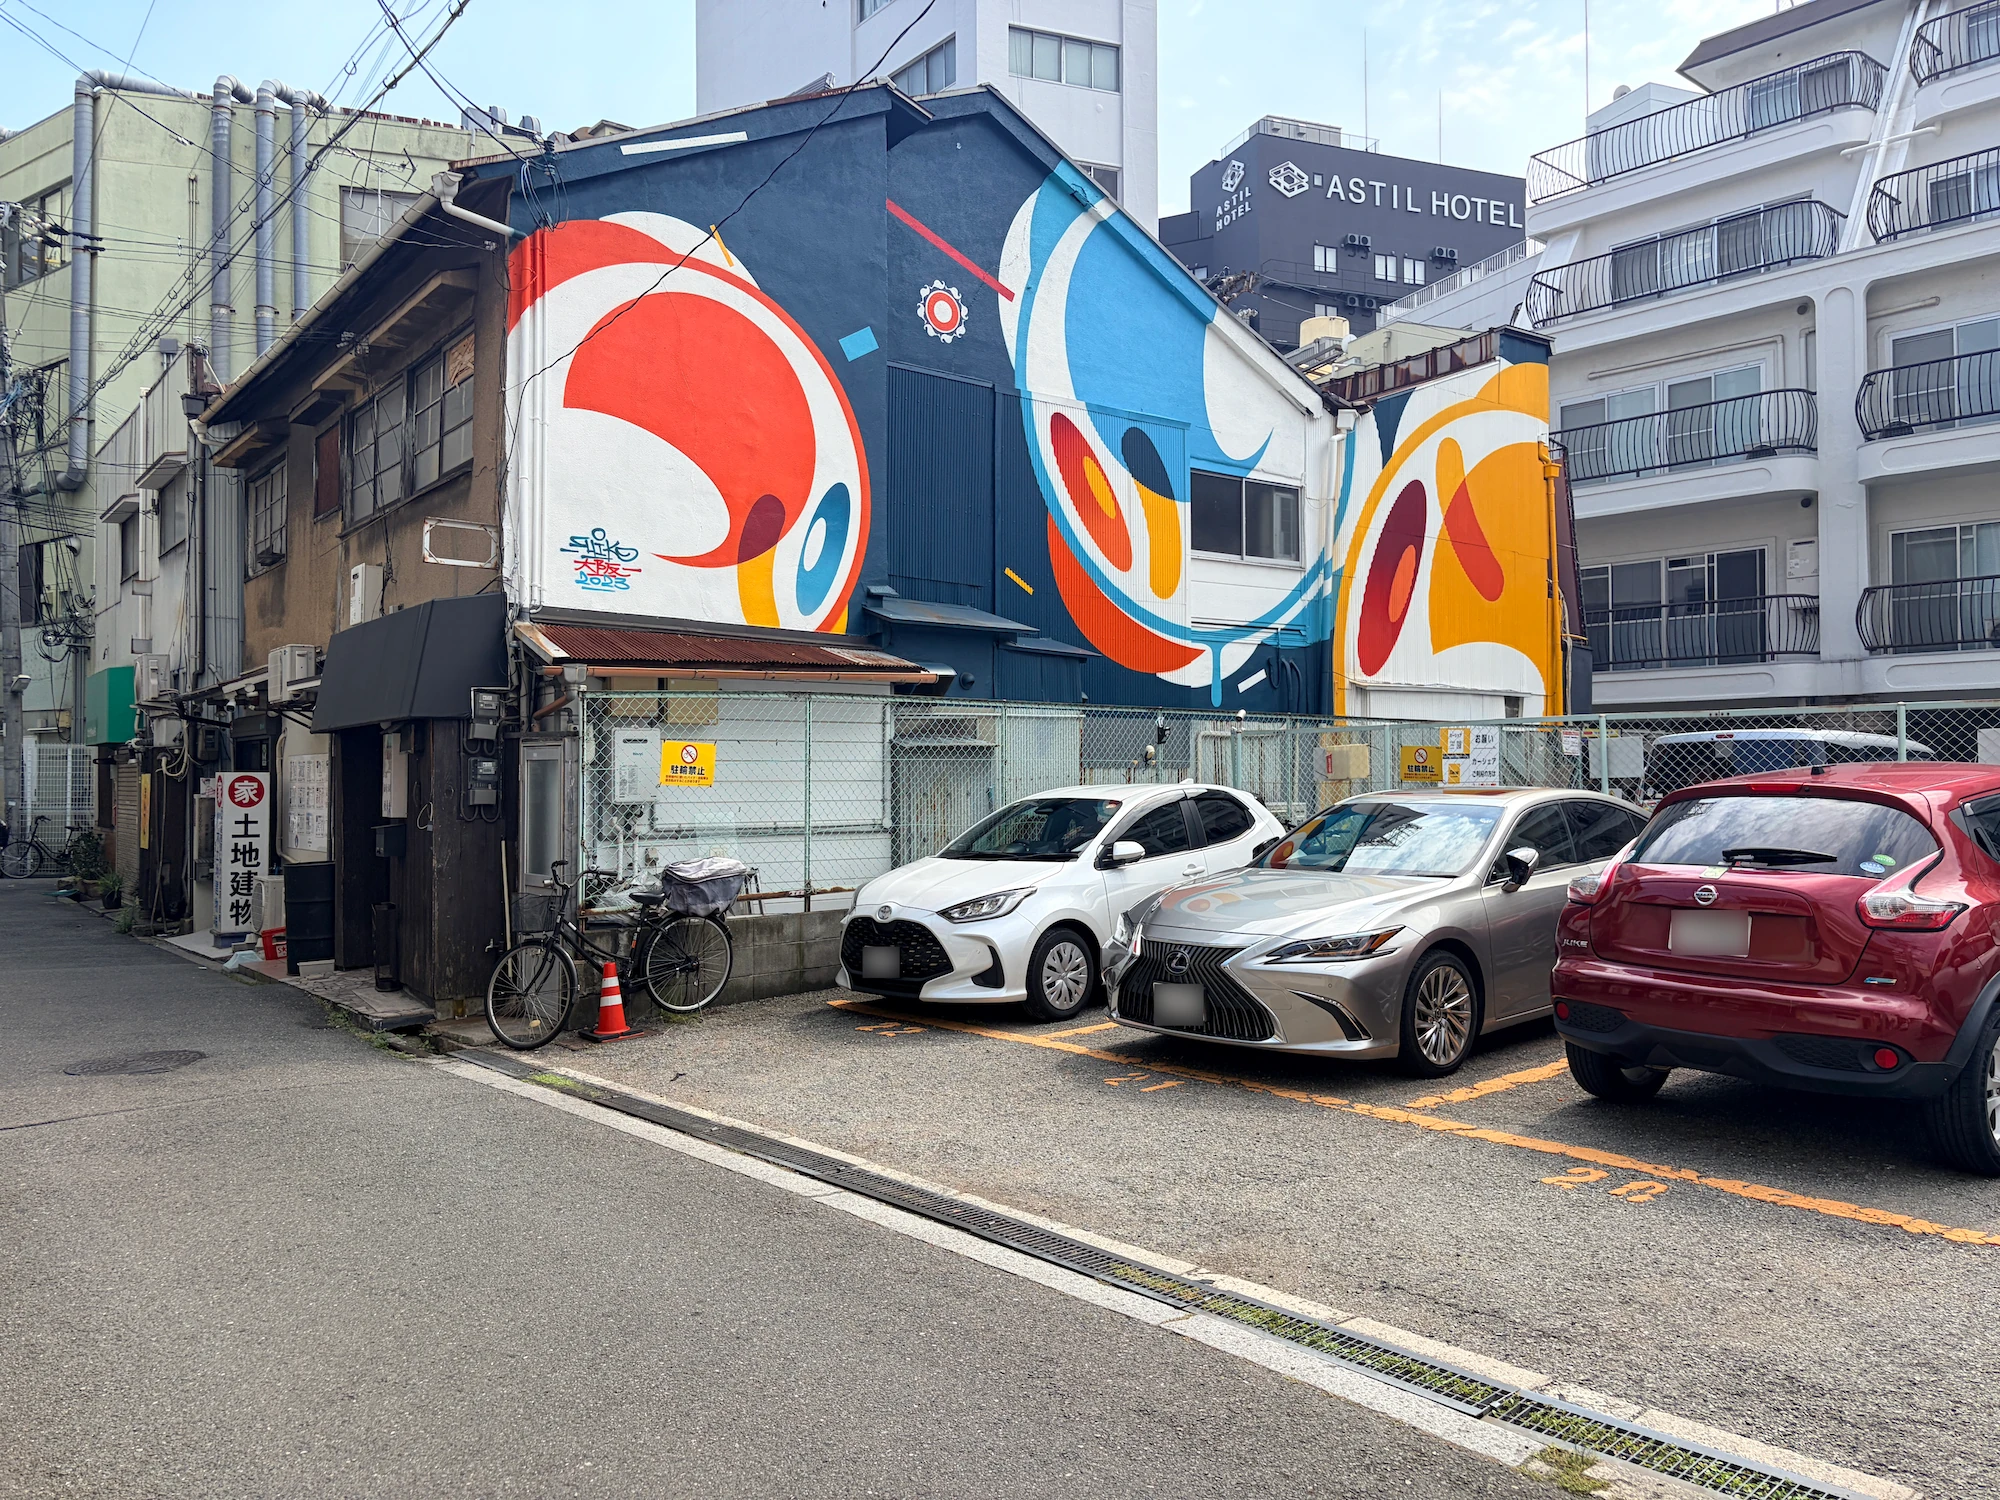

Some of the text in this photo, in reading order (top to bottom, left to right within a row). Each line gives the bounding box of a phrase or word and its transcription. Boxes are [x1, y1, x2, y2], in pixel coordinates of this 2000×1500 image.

[1216, 187, 1252, 218] ASTIL
[1326, 174, 1523, 229] ASTIL HOTEL
[1216, 202, 1252, 231] HOTEL
[573, 558, 632, 578] 大阪
[575, 570, 630, 590] 2023
[1474, 734, 1494, 744] お願い
[671, 765, 706, 776] 駐輪禁止
[1407, 764, 1435, 773] 駐輪禁止
[1472, 757, 1496, 765] カーシェア
[229, 780, 261, 926] 家 土地建物
[1561, 938, 1589, 948] JUKE
